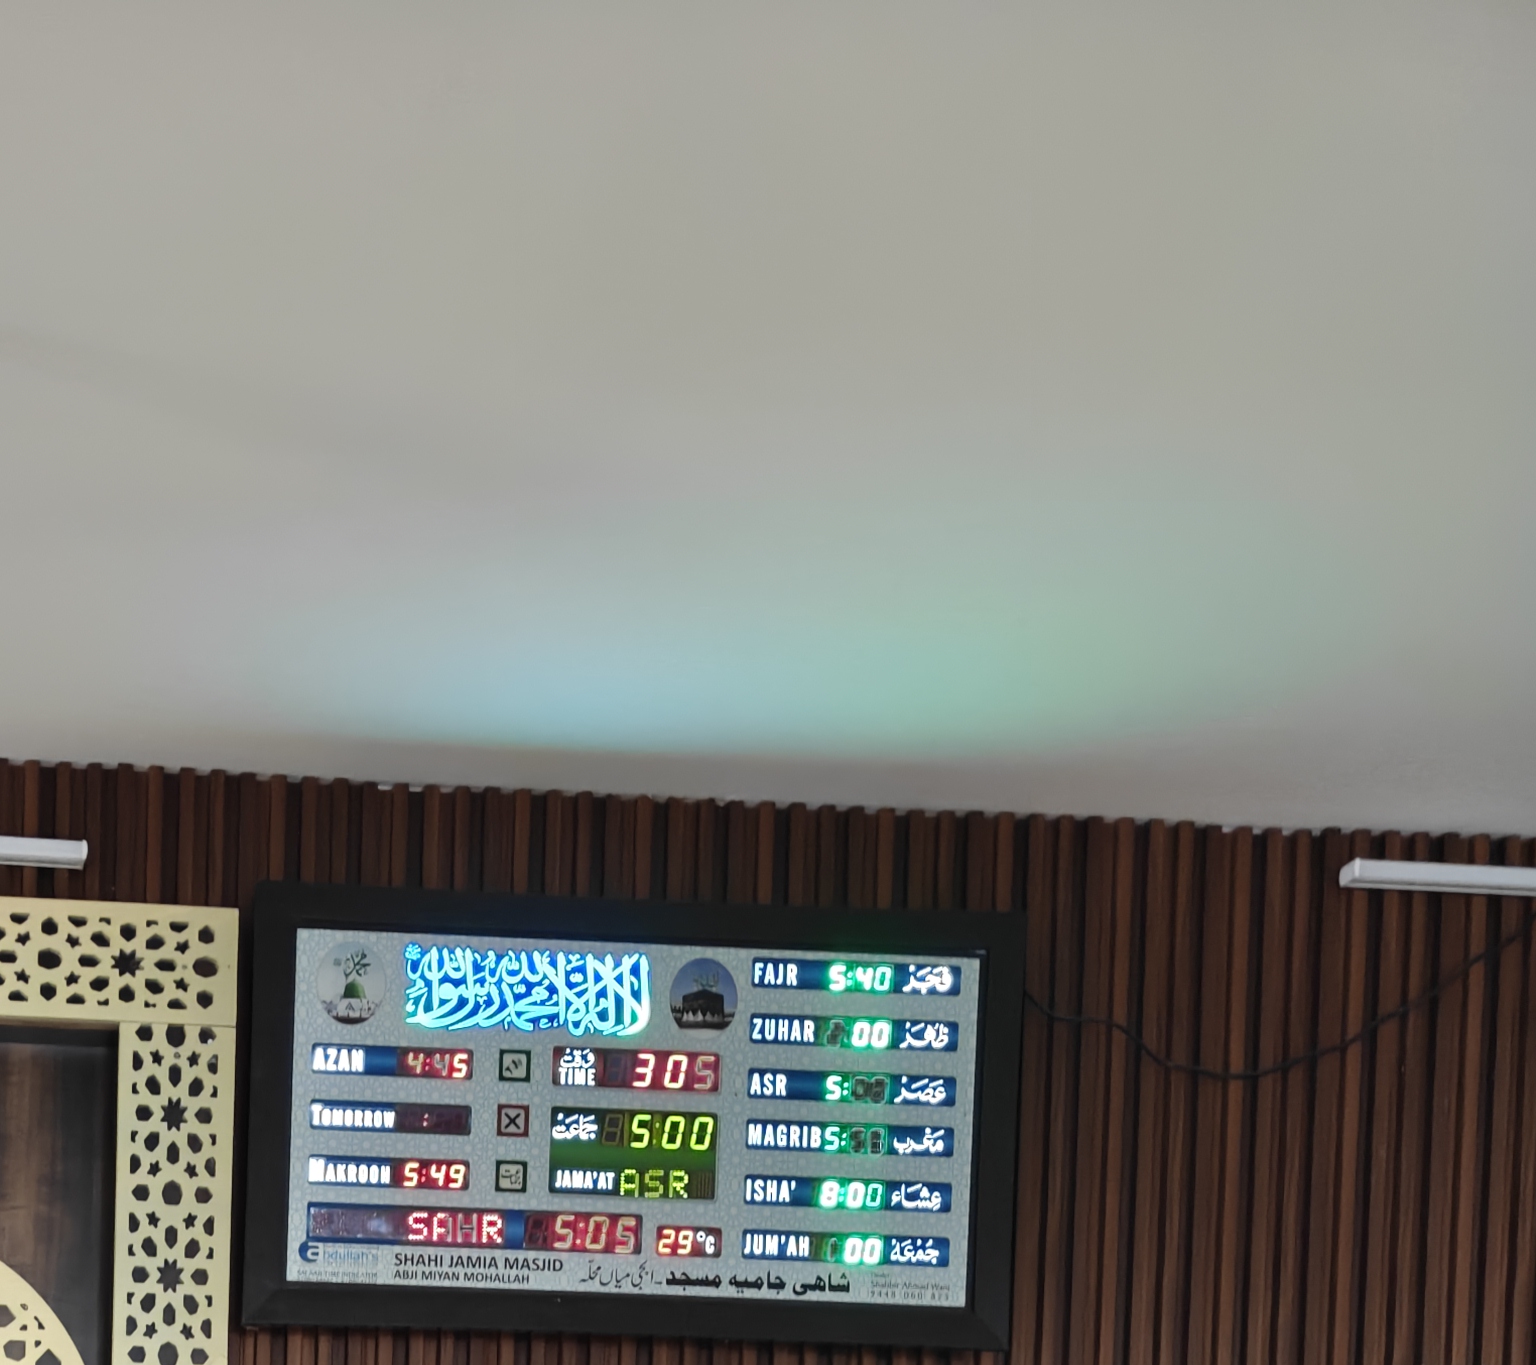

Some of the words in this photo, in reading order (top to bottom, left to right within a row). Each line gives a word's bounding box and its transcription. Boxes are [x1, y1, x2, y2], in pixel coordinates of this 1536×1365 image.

[754, 962, 798, 986] FAJR
[829, 964, 892, 992] 5:40
[752, 1018, 815, 1043] ZUHAR
[313, 1048, 364, 1072] AZAN
[408, 1052, 469, 1078] 4:45
[559, 1067, 596, 1086] TIME
[750, 1073, 787, 1097] ASR
[312, 1103, 396, 1128] TOMORROW
[630, 1114, 714, 1151] 5:00
[748, 1123, 822, 1148] MAGRIB
[309, 1158, 391, 1184] MAKROOH
[404, 1161, 466, 1188] 5:49
[555, 1169, 615, 1190] JAMA'AT
[620, 1169, 689, 1198] ASR
[745, 1178, 796, 1202] ISHA'
[819, 1180, 883, 1209] 8:00
[408, 1211, 503, 1244] SAHR
[553, 1214, 636, 1254] 5:05
[744, 1233, 810, 1257] JUM'AH
[395, 1253, 443, 1267] SHAHI
[449, 1255, 498, 1269] JAMIA
[505, 1257, 563, 1272] MASJID
[394, 1270, 418, 1280] ABJI
[421, 1270, 460, 1282] MIYAN
[464, 1272, 529, 1285] MOHALLAH
[666, 1270, 722, 1291] مسجد
